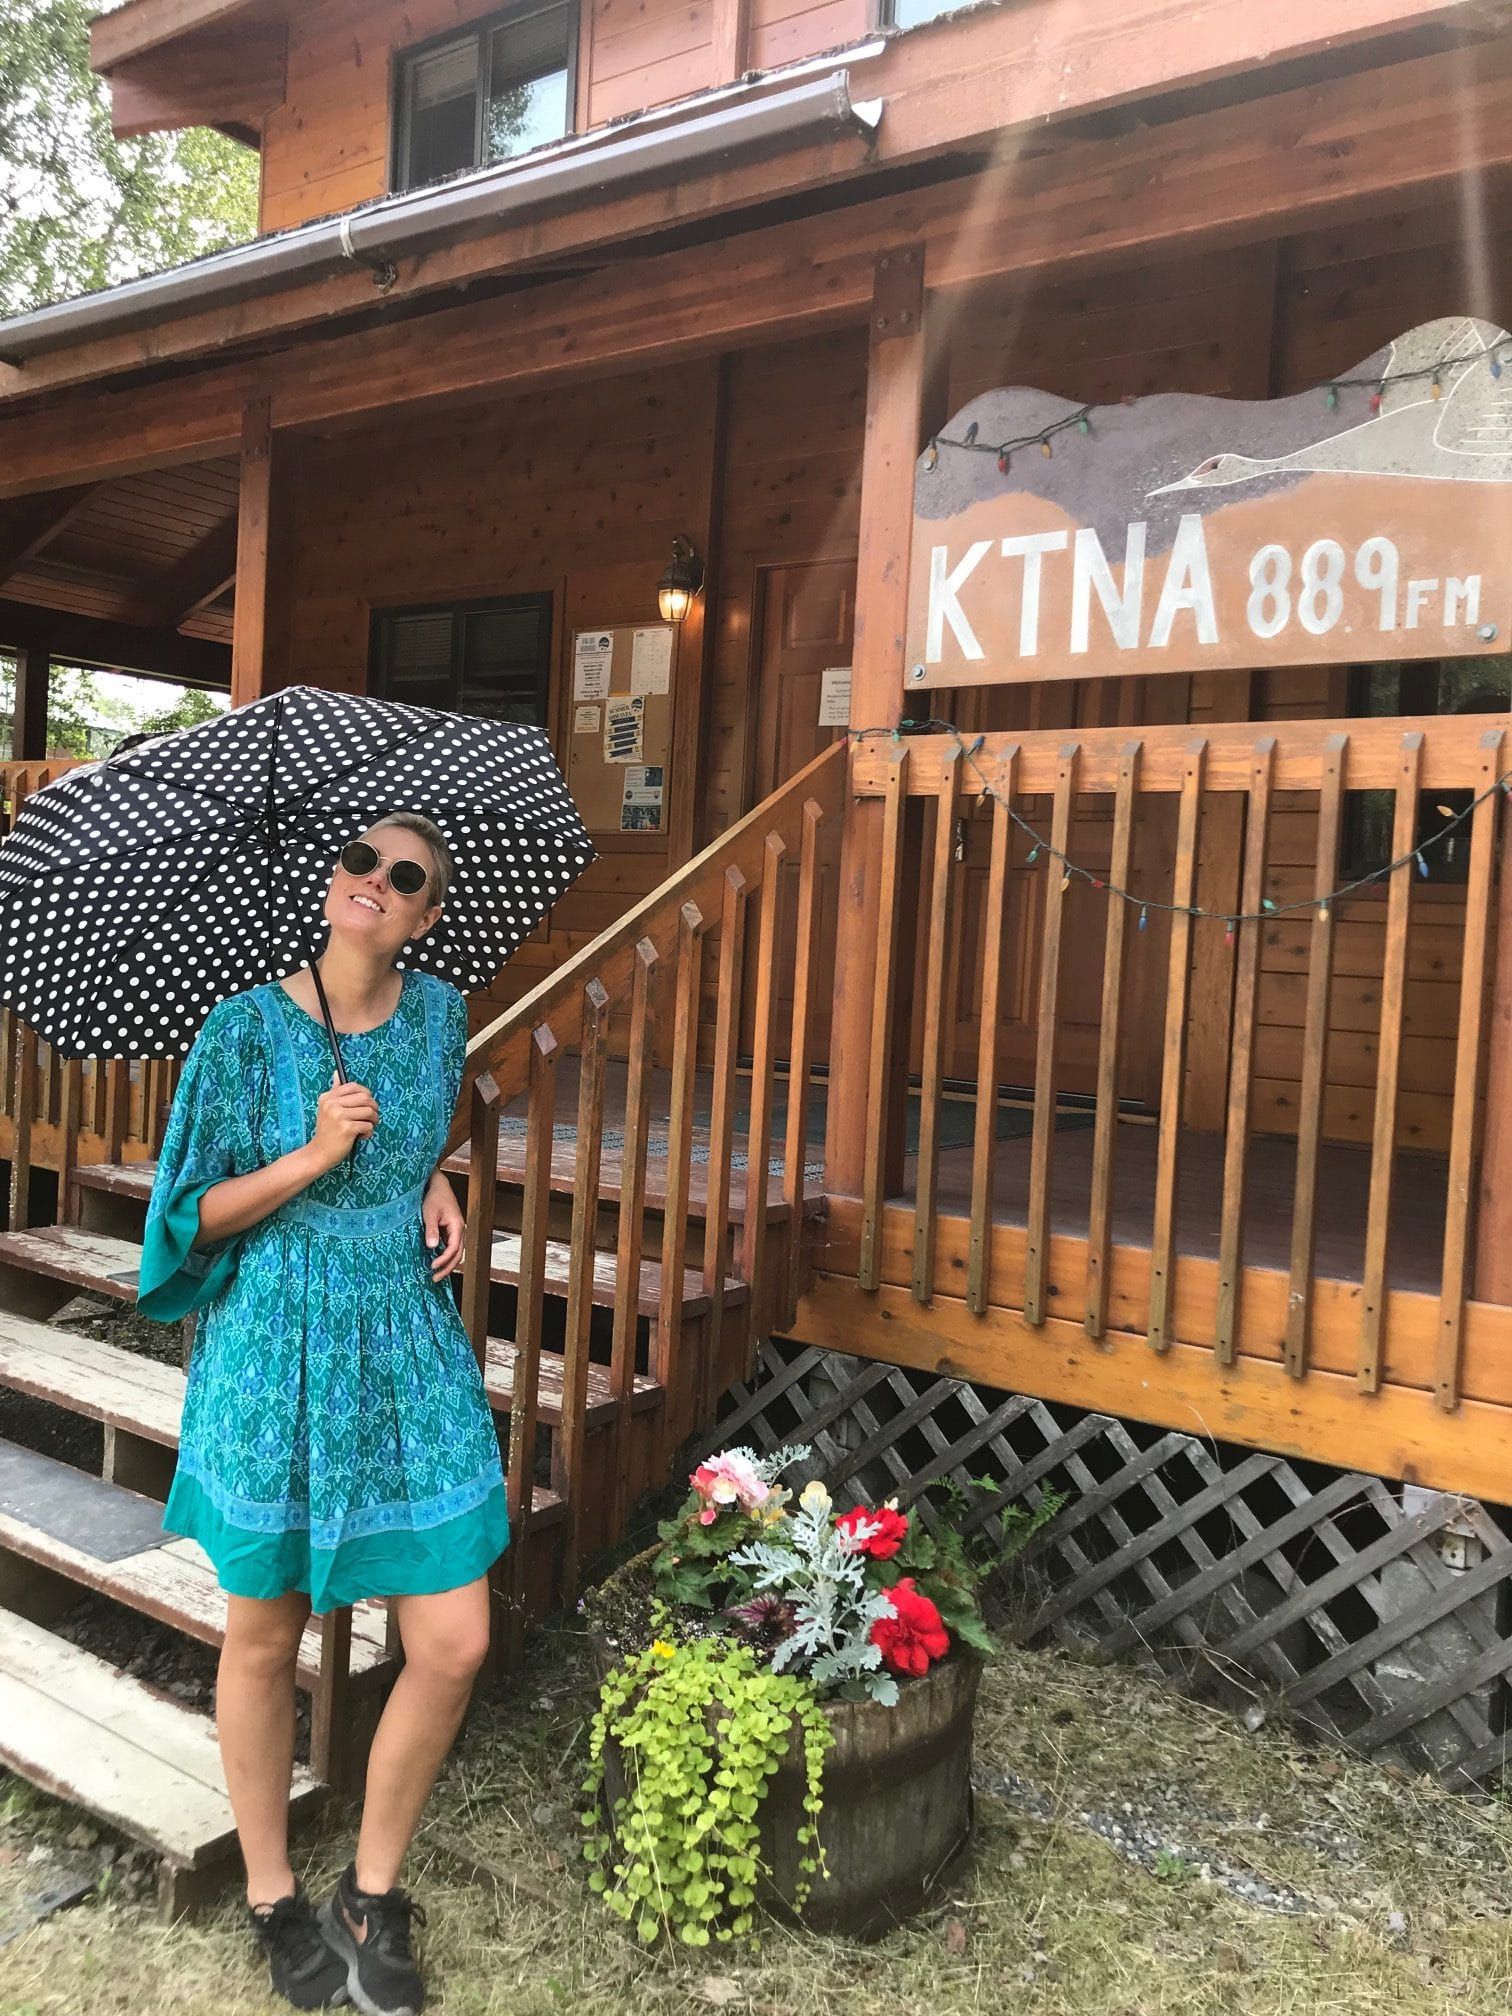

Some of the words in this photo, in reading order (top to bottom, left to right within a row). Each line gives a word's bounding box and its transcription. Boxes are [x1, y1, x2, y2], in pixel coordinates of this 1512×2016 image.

[925, 513, 1219, 663] KTNA
[1246, 536, 1399, 639] 88.9
[1405, 574, 1482, 629] FM
